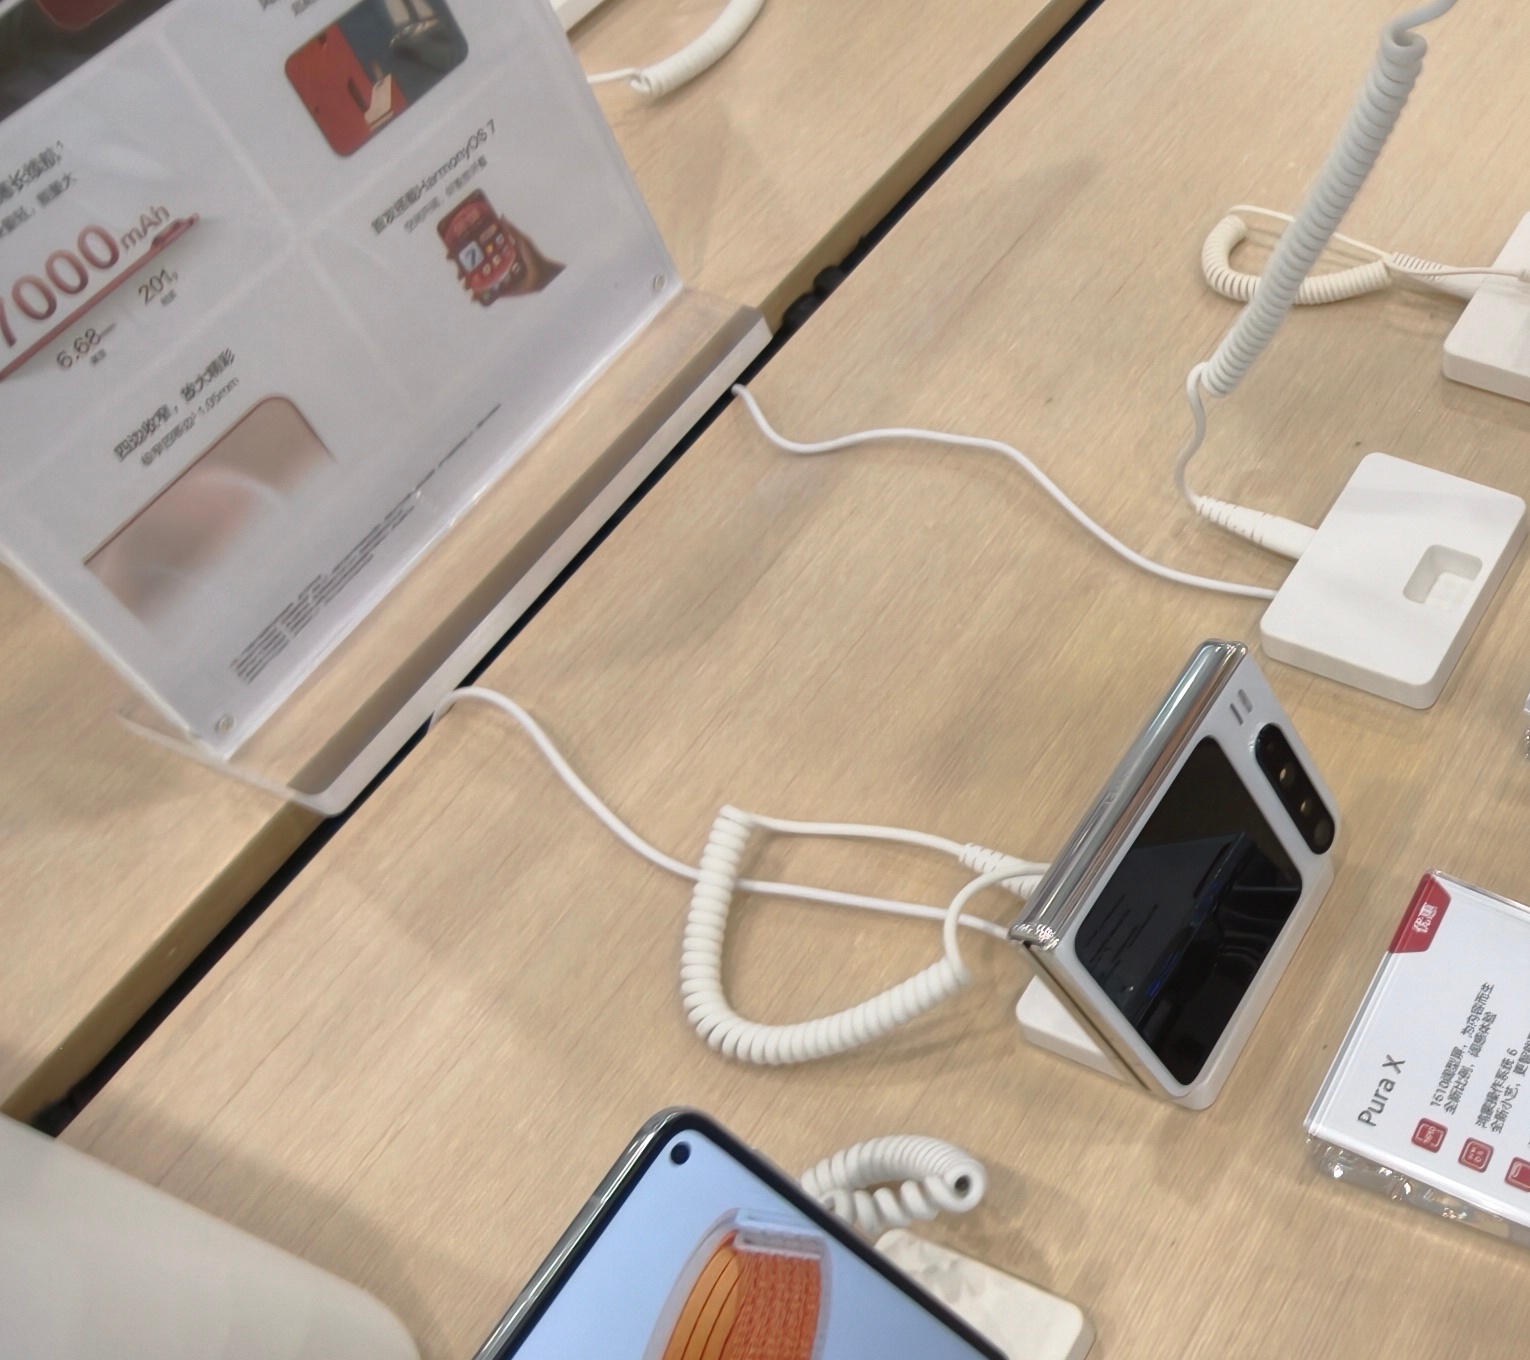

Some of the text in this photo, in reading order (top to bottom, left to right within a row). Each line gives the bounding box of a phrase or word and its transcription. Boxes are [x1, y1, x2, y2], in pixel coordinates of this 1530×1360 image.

[1412, 901, 1437, 933] 优惠
[1357, 1054, 1405, 1126] Pura X
